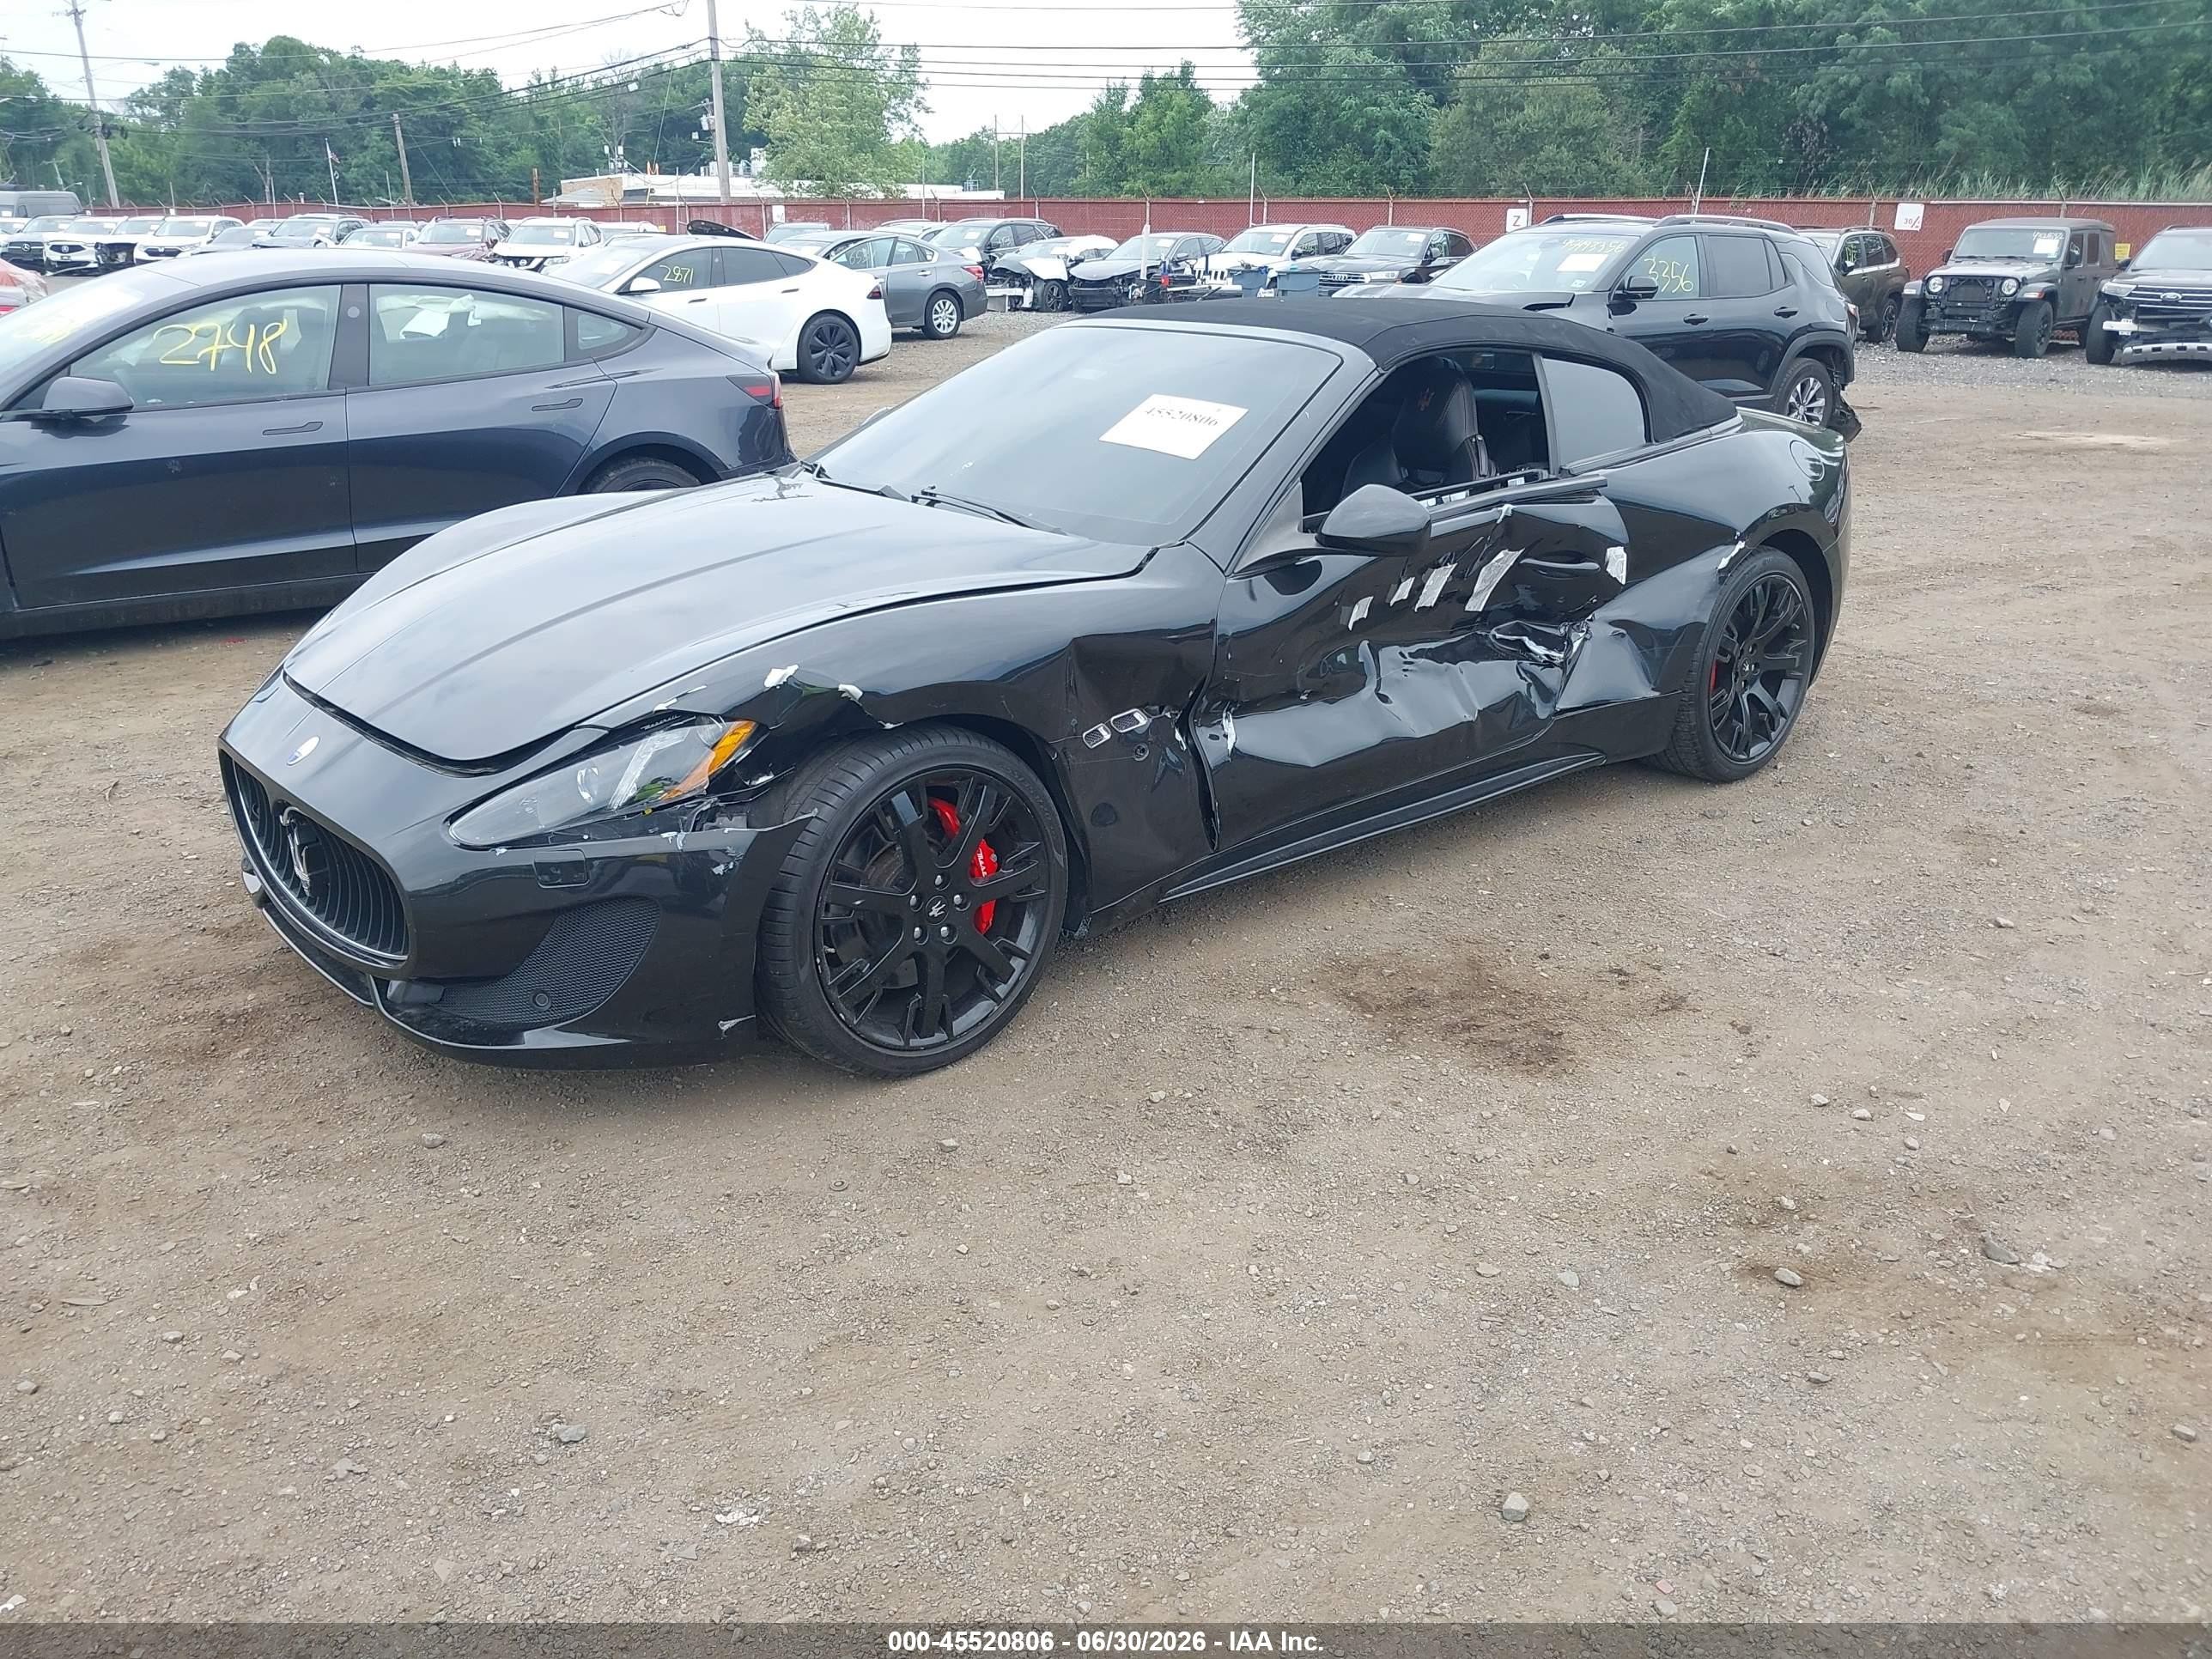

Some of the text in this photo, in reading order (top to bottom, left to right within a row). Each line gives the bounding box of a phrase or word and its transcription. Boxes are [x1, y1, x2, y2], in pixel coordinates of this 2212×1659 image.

[1512, 215, 1521, 227] Z
[659, 264, 694, 286] 2871
[1644, 257, 1694, 293] 3356
[153, 319, 288, 374] 2748
[1145, 406, 1218, 427] 45520806
